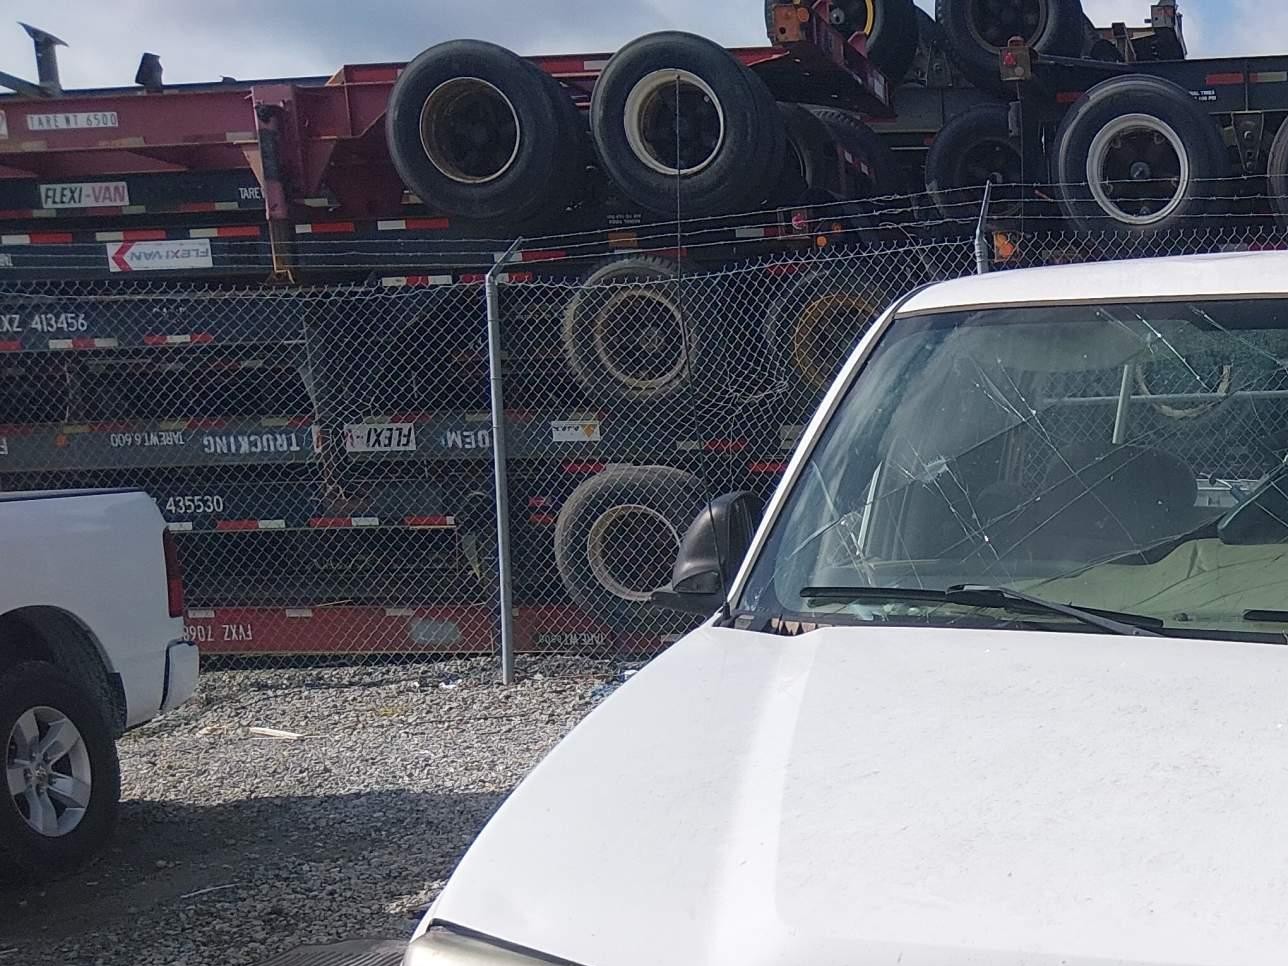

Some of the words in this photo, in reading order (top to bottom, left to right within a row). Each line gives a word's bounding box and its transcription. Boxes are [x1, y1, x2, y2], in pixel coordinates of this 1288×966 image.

[86, 111, 117, 127] 6500
[44, 184, 126, 205] FLEXI-VAN
[31, 313, 88, 332] 413456
[203, 432, 301, 454] TRUCKING
[166, 495, 224, 513] 435530
[221, 624, 253, 641] FVXZ
